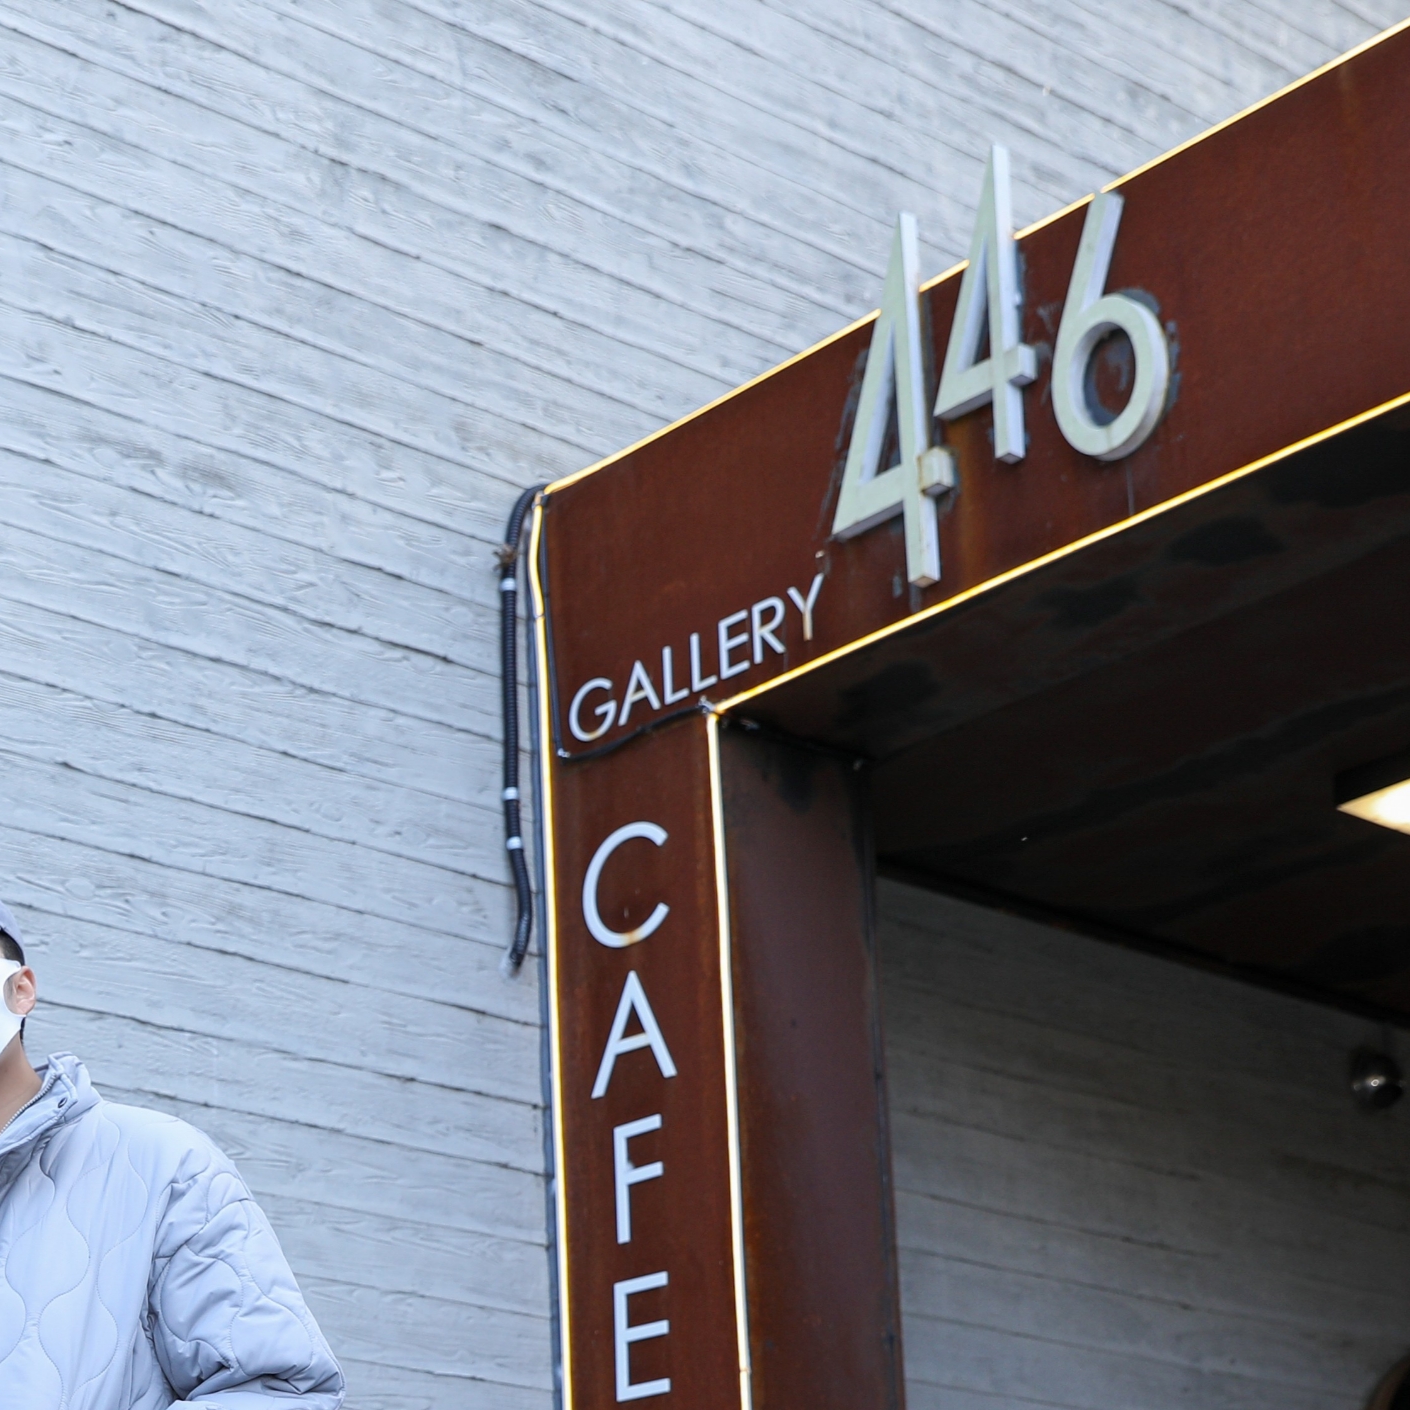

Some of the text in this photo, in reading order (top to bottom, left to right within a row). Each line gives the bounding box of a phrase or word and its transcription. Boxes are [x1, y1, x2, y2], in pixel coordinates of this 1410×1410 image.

[832, 143, 1170, 588] 446
[569, 573, 824, 742] GALLERY
[582, 821, 677, 1402] CAFE
